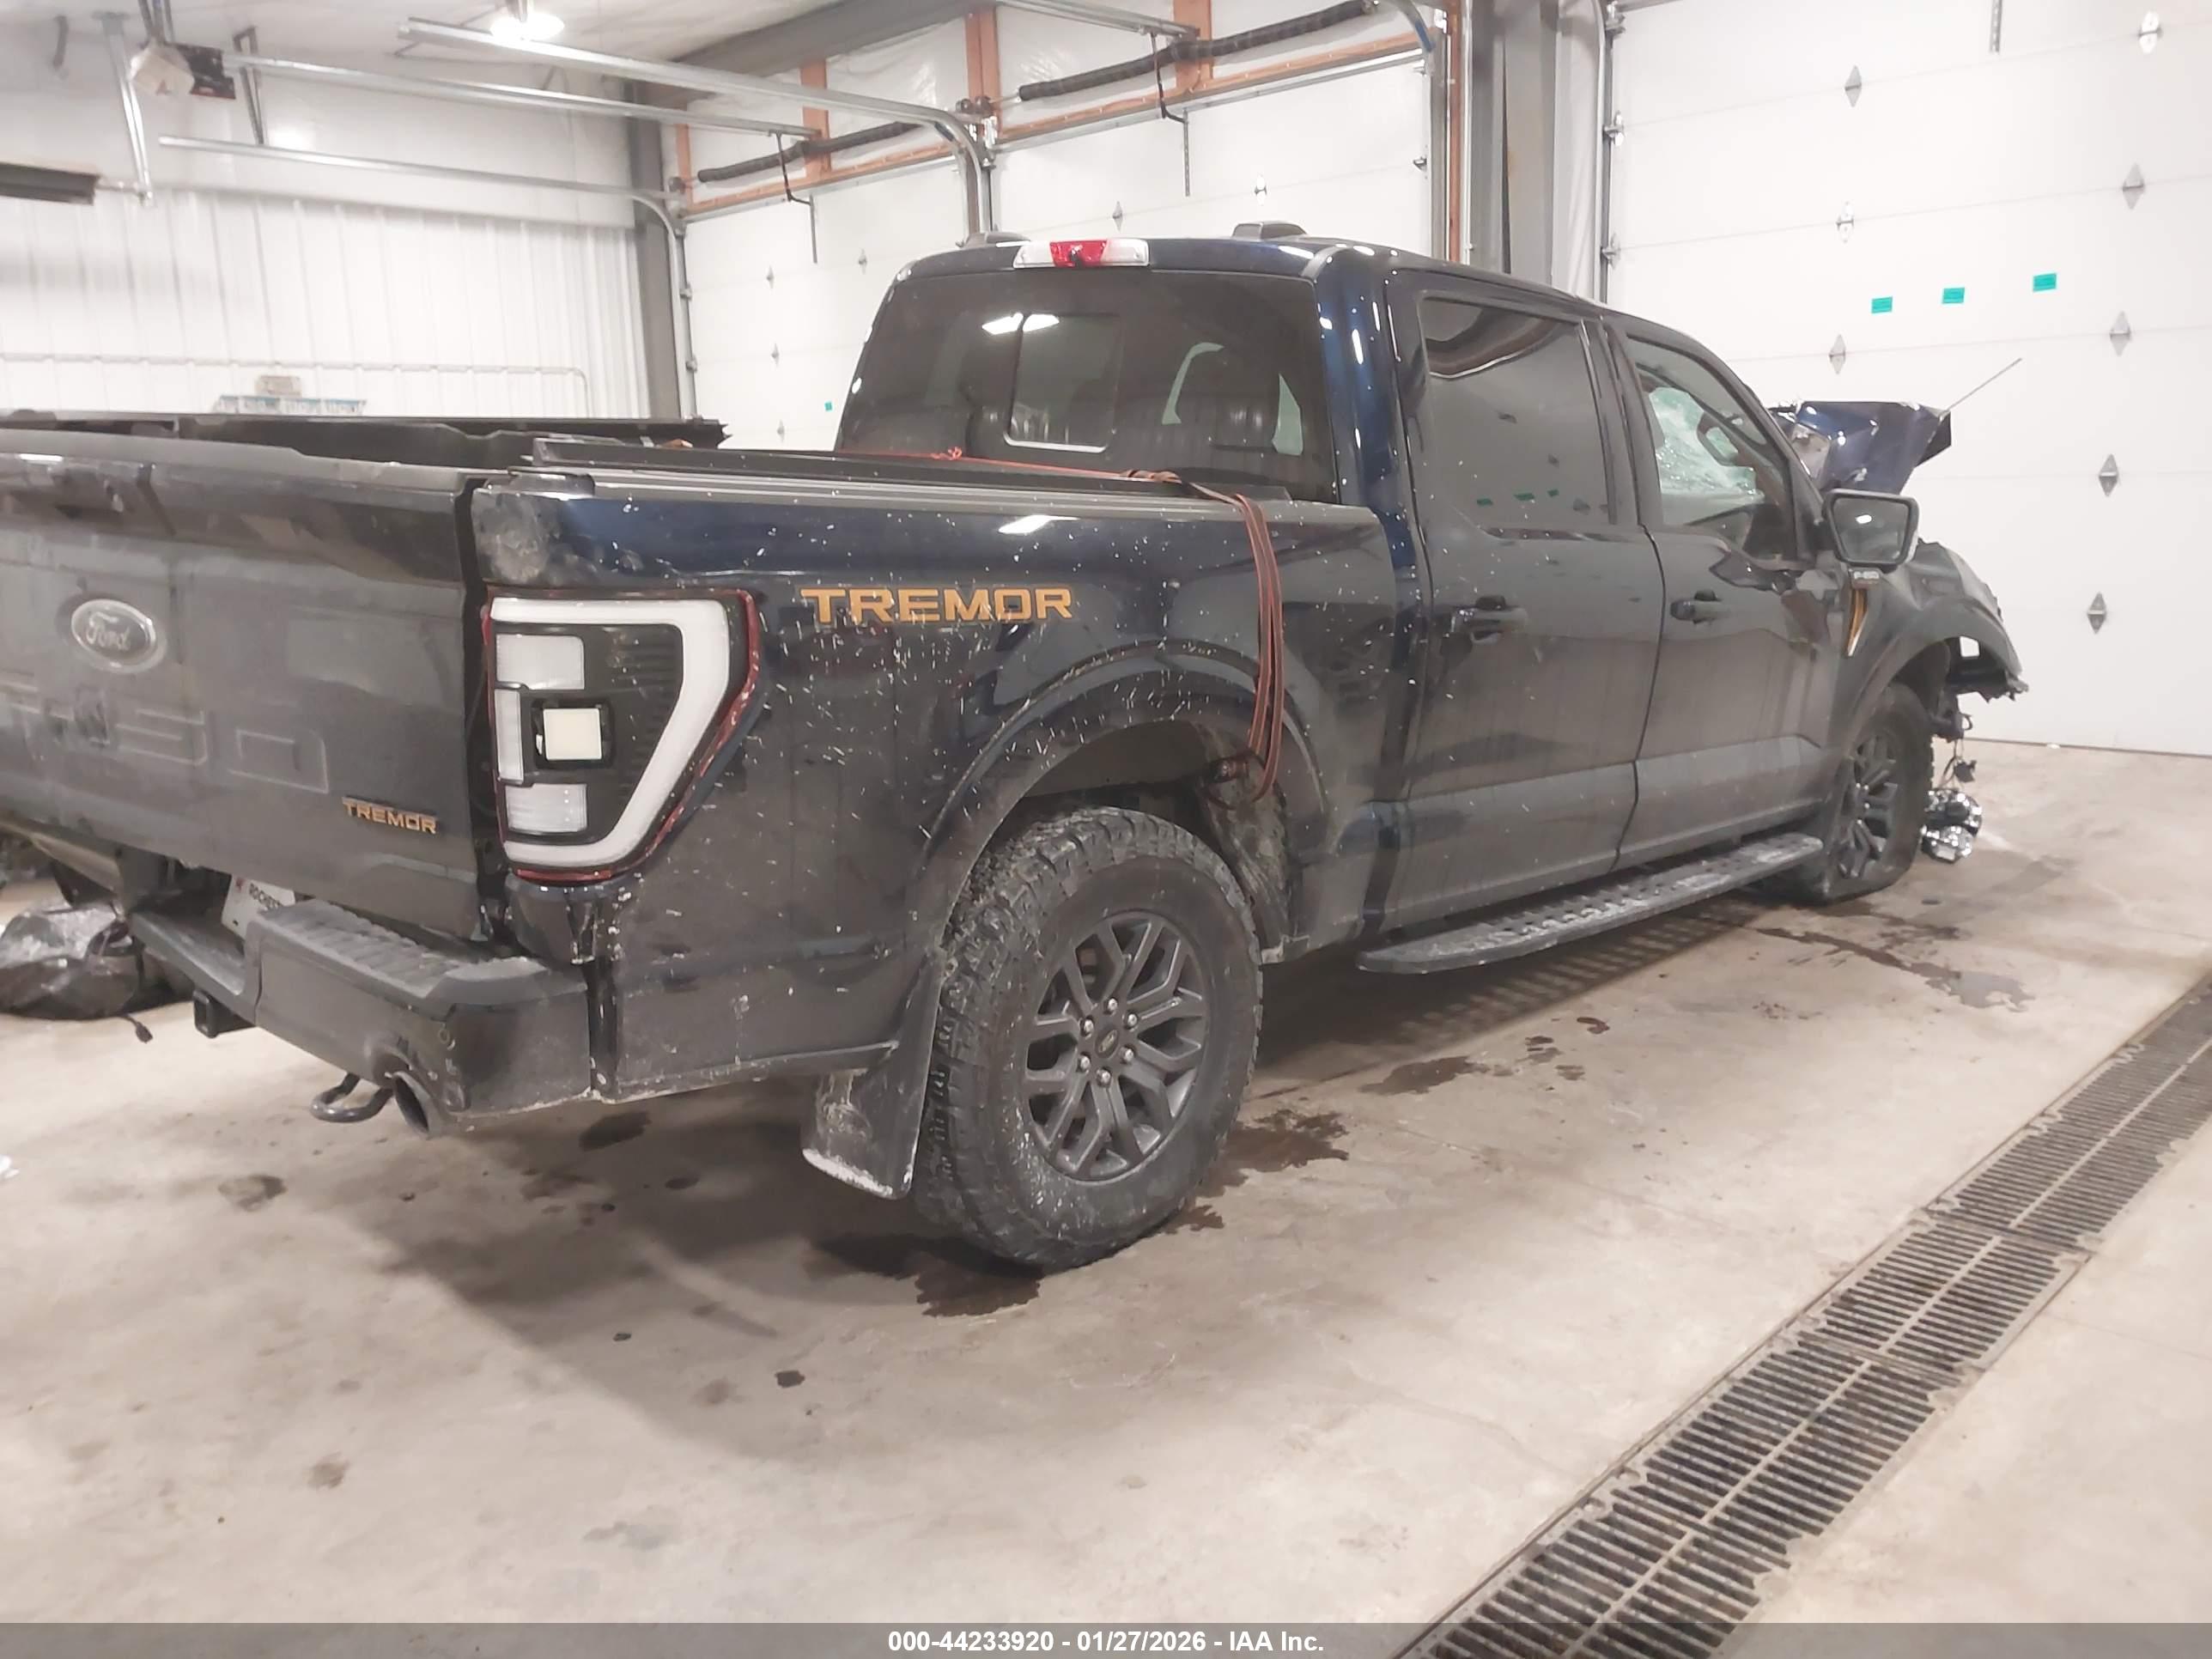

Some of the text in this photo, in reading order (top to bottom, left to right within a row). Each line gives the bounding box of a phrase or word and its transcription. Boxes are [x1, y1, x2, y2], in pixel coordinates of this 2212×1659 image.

[800, 587, 1073, 624] TREMOR
[87, 611, 131, 651] Ford
[342, 796, 438, 835] TREMOR
